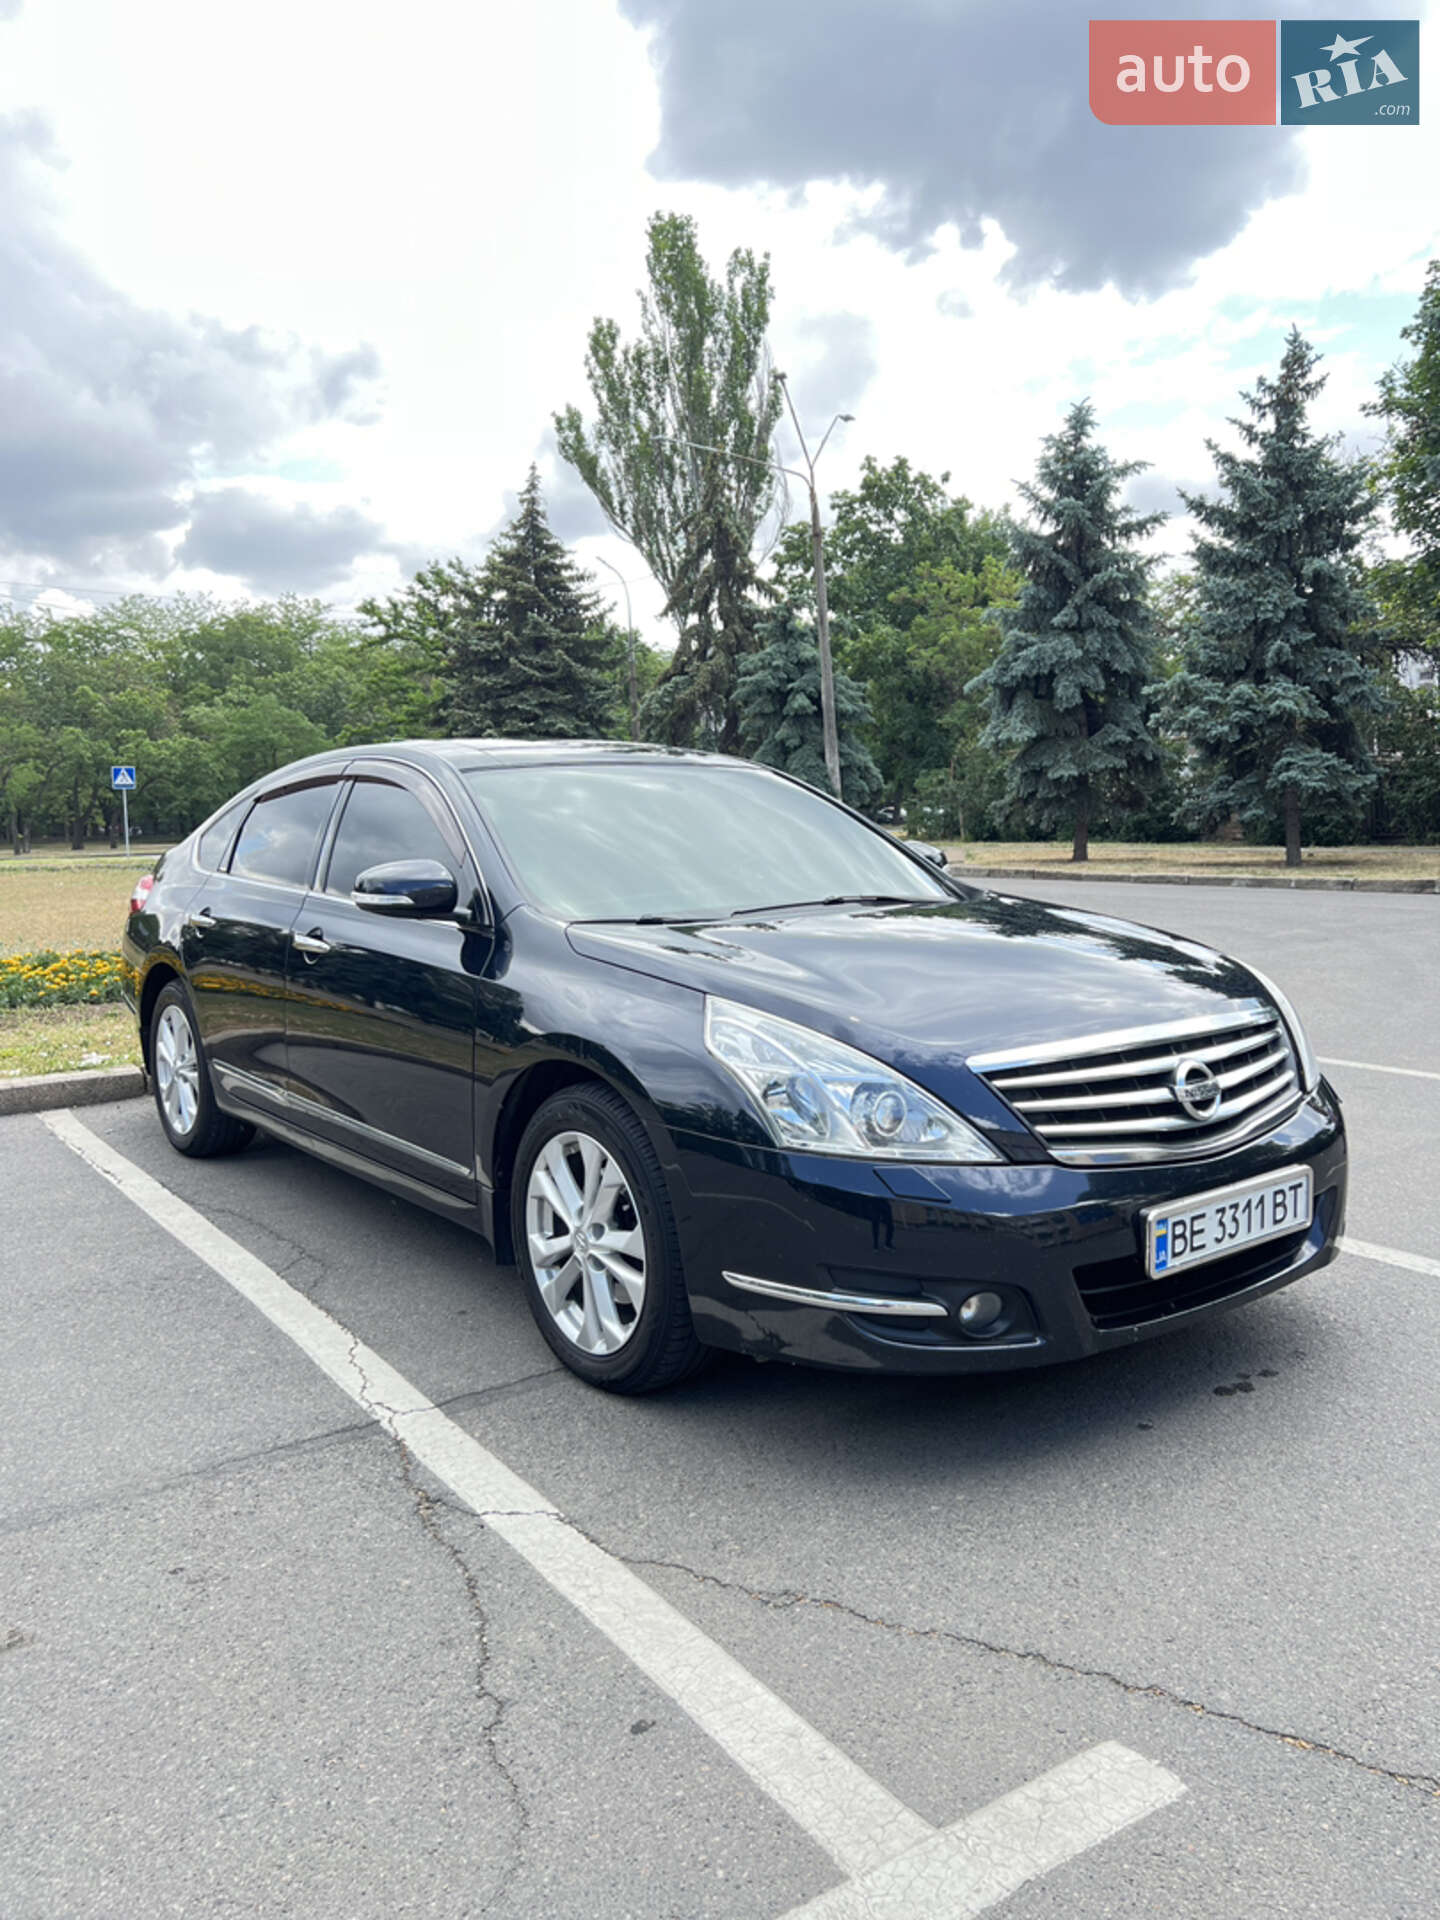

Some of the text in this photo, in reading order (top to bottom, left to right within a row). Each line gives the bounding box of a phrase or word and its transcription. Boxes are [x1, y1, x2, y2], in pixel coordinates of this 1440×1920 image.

[1171, 1182, 1303, 1259] BE 3311 BT
